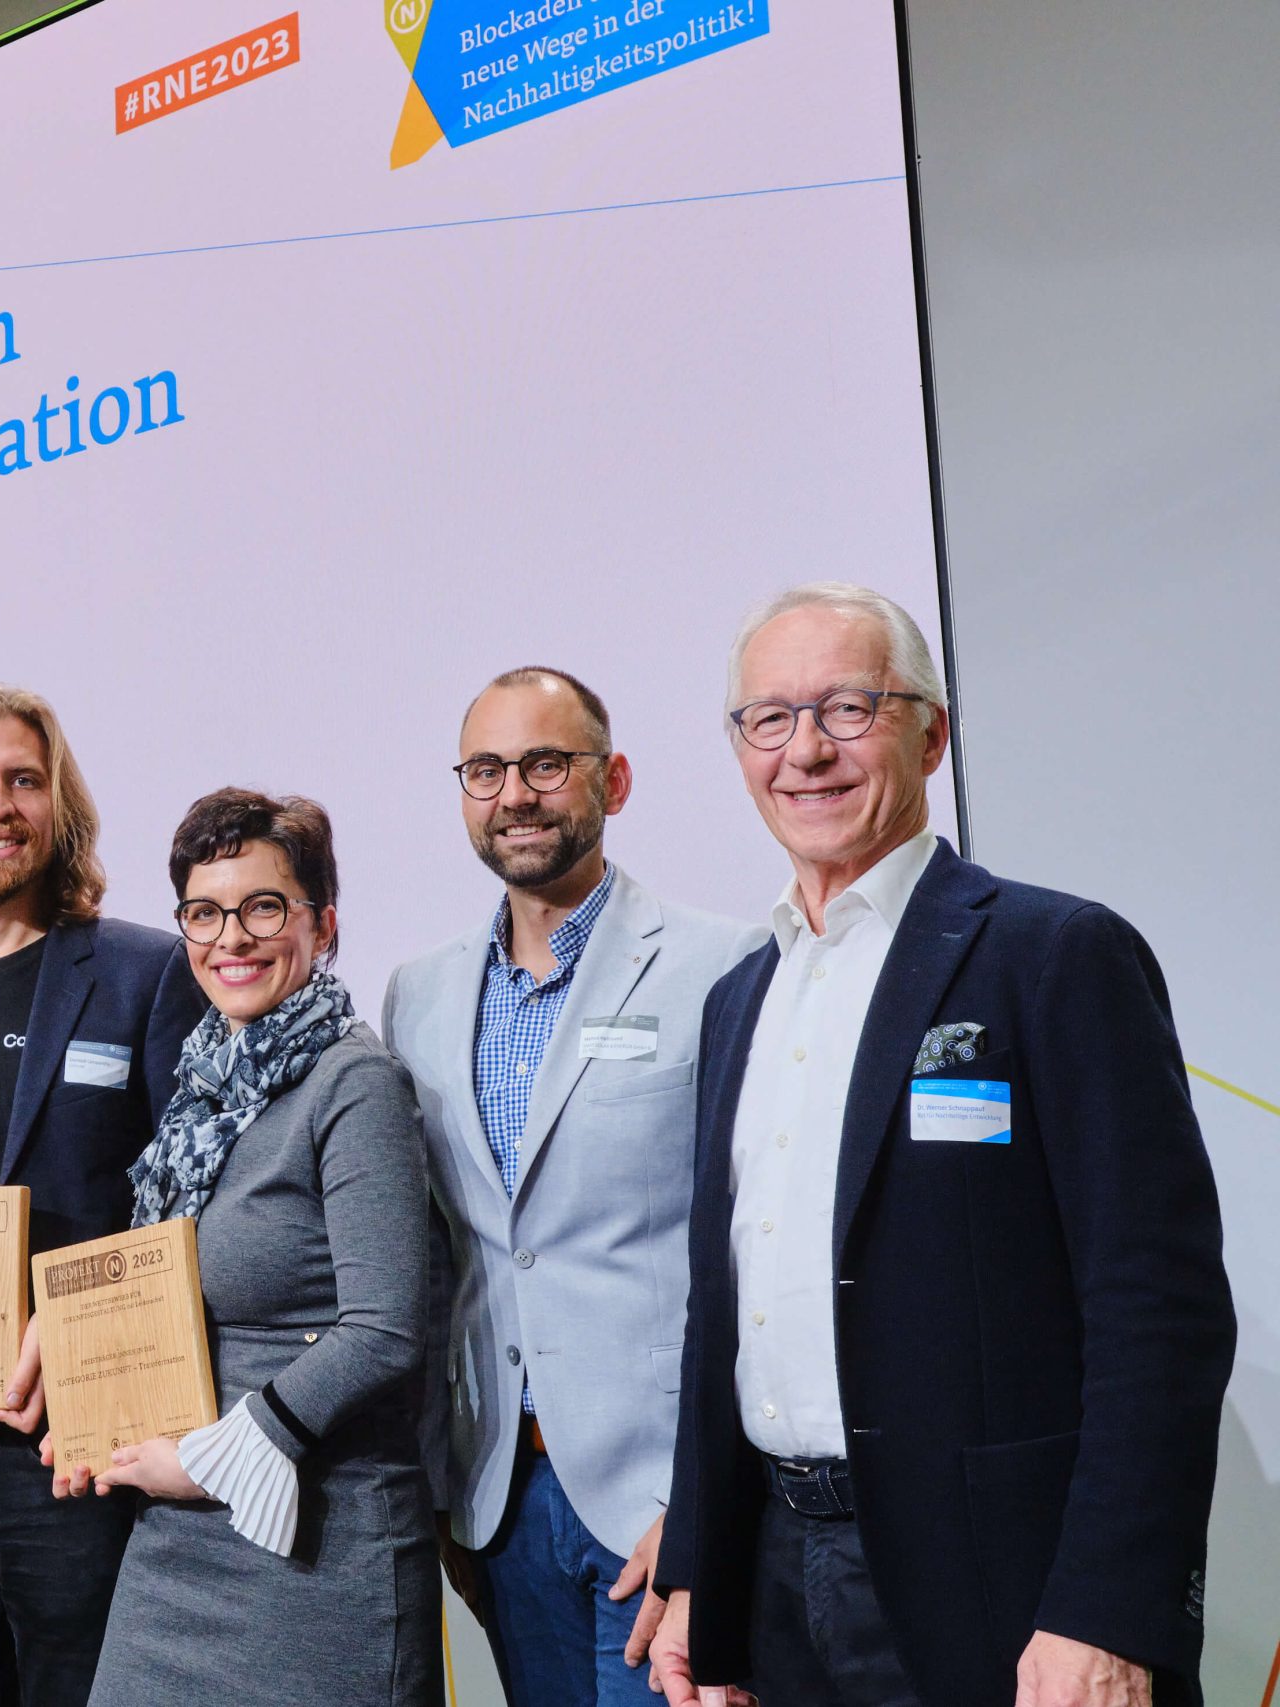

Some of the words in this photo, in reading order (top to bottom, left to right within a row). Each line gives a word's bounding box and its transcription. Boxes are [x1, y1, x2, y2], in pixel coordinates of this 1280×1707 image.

[124, 29, 290, 122] #RNE2023
[461, 55, 519, 90] neue
[523, 26, 588, 65] Wege
[593, 14, 620, 40] in
[624, 0, 665, 27] der
[463, 0, 755, 129] Nachhaltigkeitspolitik!
[51, 1261, 103, 1283] PROJEKT
[132, 1249, 164, 1269] 2023
[56, 1373, 98, 1389] KATEGORIE
[98, 1364, 133, 1380] ZUKUNFT
